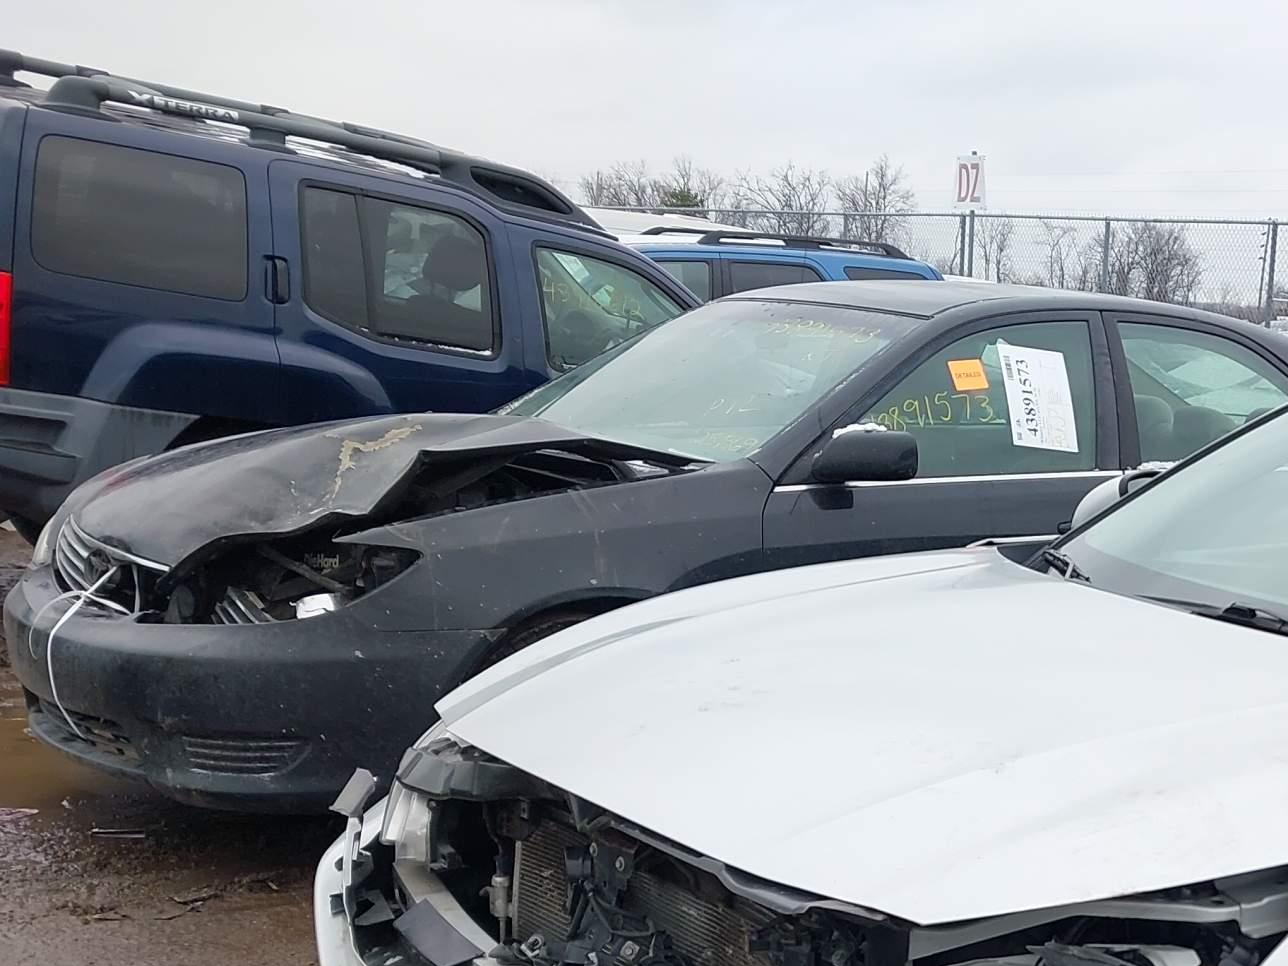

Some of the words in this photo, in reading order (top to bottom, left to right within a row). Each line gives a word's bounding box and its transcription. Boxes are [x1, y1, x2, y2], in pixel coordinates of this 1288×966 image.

[127, 90, 240, 121] XTERRA
[956, 162, 981, 203] DZ
[1015, 358, 1040, 438] 43891573
